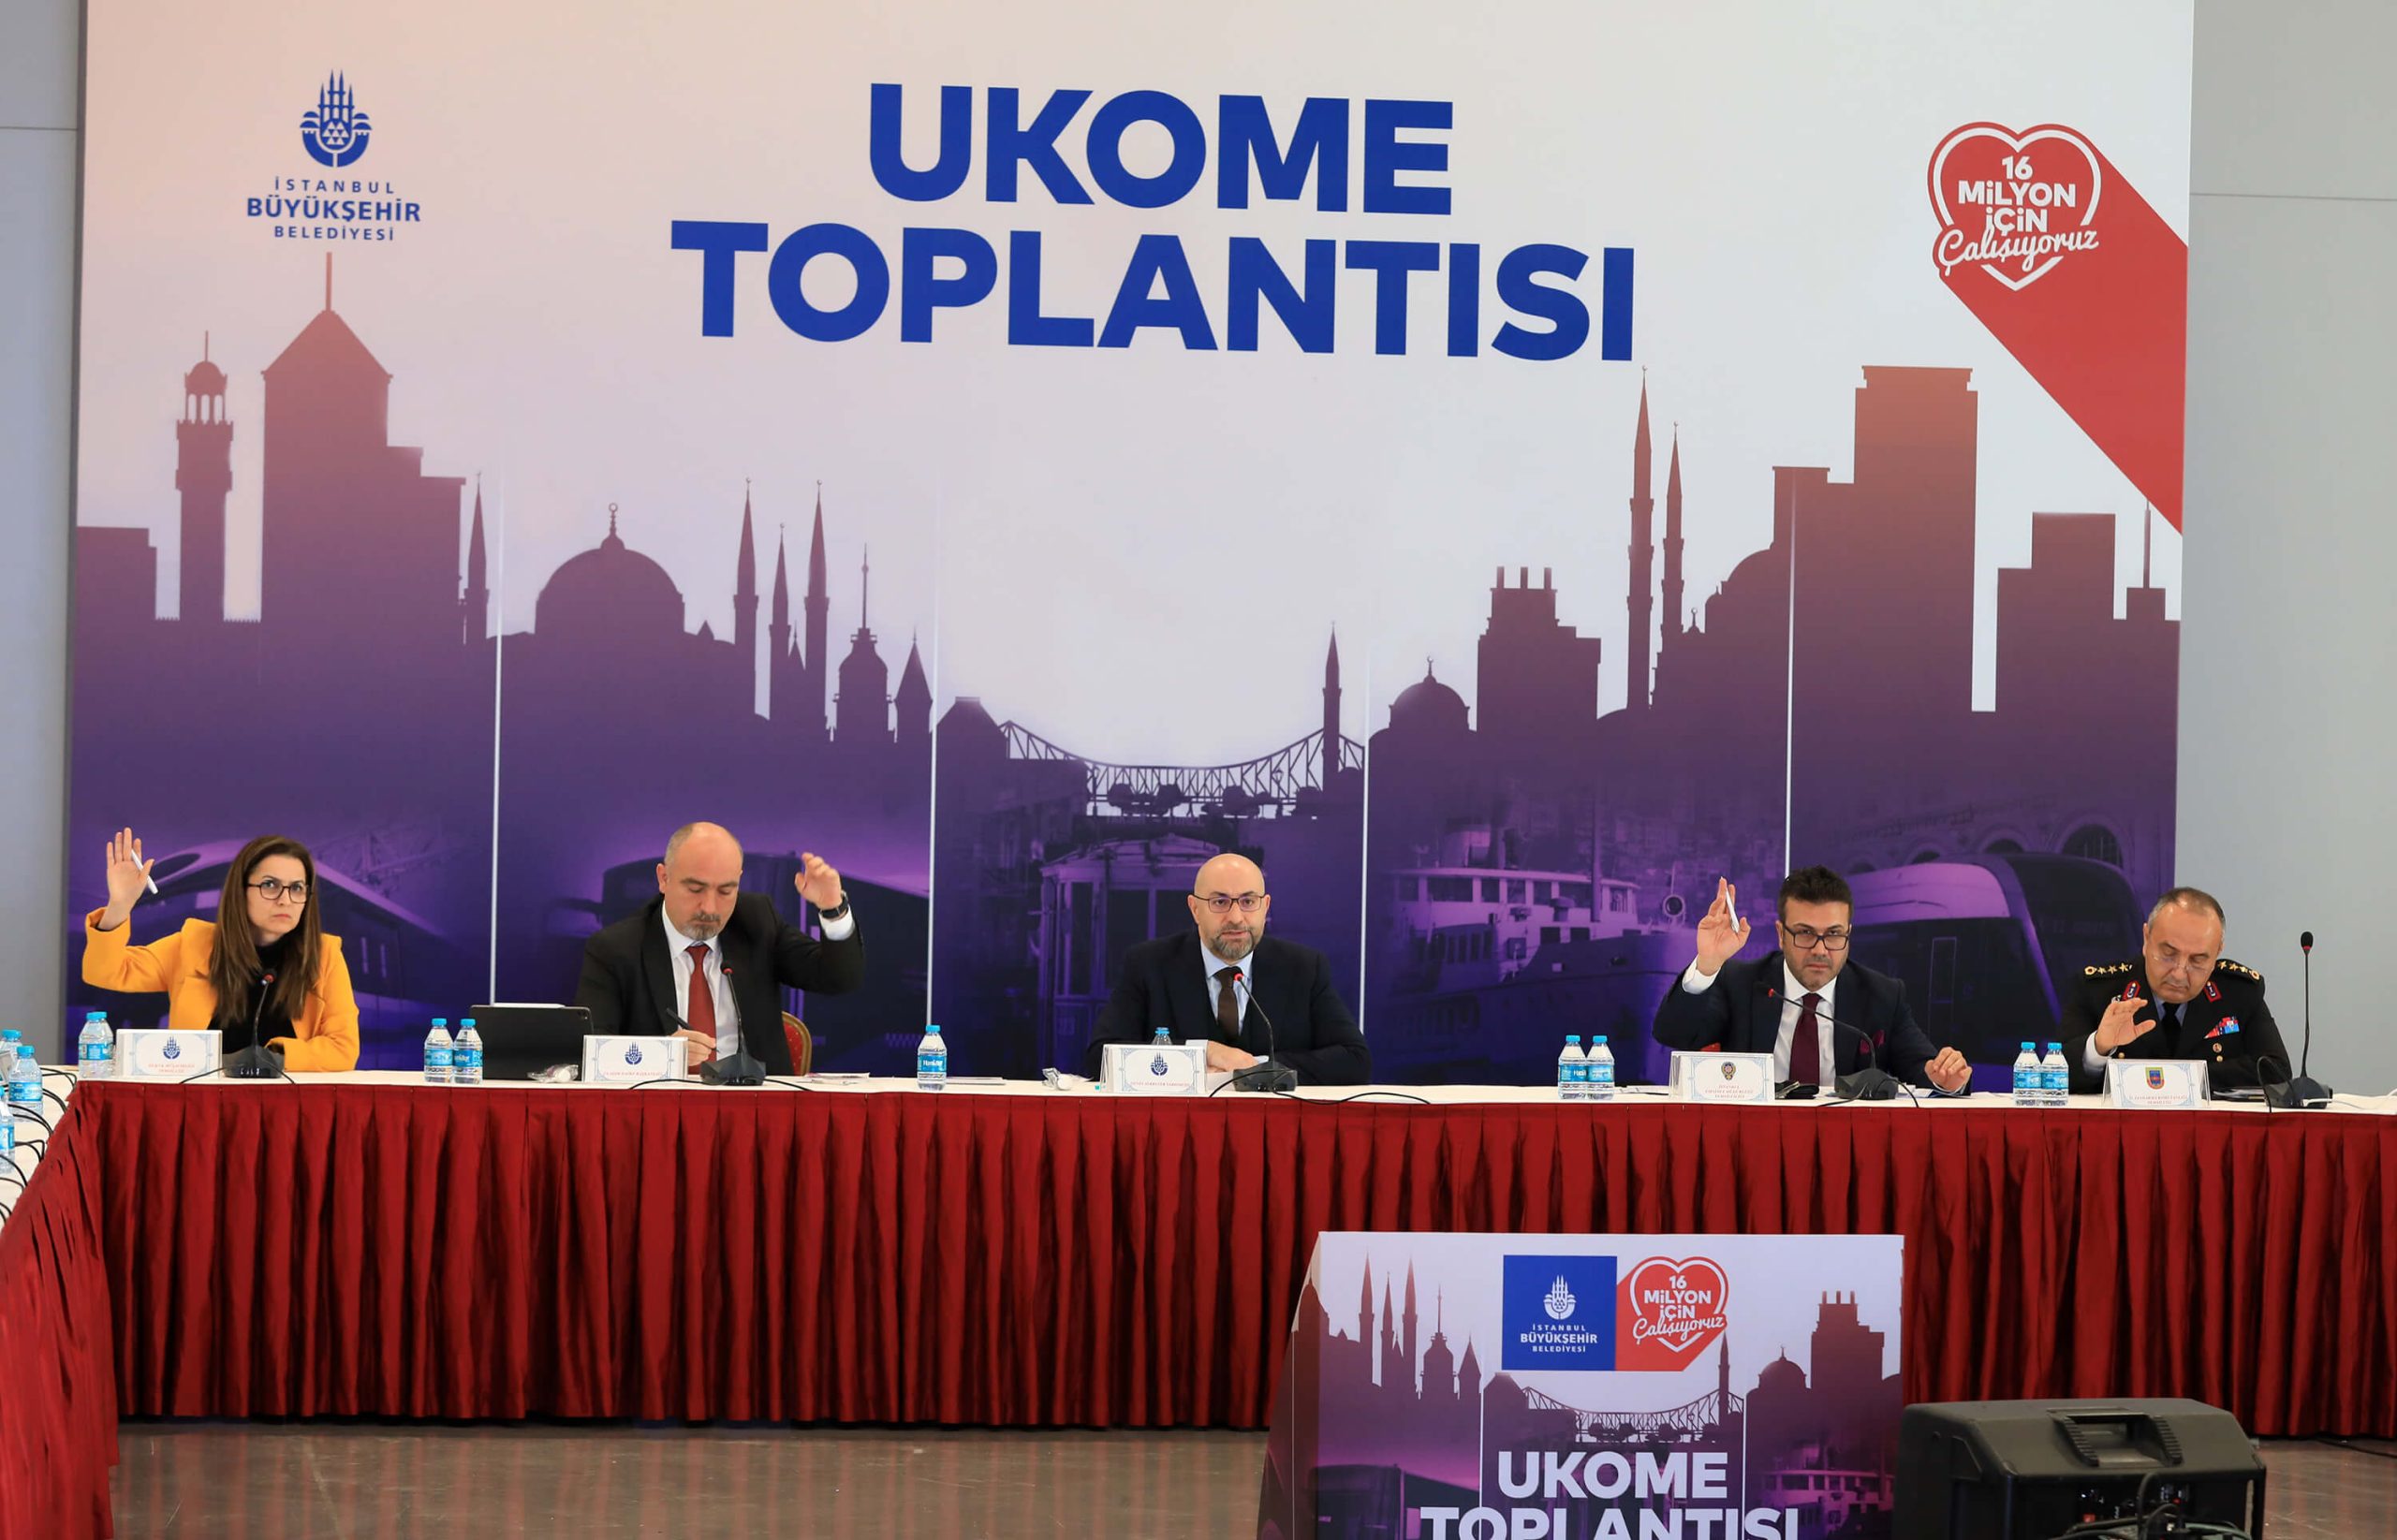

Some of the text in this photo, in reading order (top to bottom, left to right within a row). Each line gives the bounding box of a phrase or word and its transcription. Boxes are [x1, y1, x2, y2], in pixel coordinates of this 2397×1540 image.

[869, 82, 1453, 216] UKOME
[2001, 155, 2033, 180] 16
[274, 176, 394, 194] İSTANBUL
[246, 194, 420, 222] BÜYÜKŞEHİR
[273, 225, 394, 242] BELEDİYESİ
[1937, 227, 2099, 276] Çalışıyoruz
[670, 219, 1635, 361] TOPLANTISI
[1669, 1275, 1687, 1290] 16
[1520, 1331, 1598, 1344] BÜYÜKŞEHİR
[1532, 1323, 1586, 1331] İSTANBUL
[1633, 1315, 1725, 1344] Çalışıyoruz
[1532, 1344, 1586, 1353] BELEDİYESİ
[1497, 1450, 1728, 1500] UKOME
